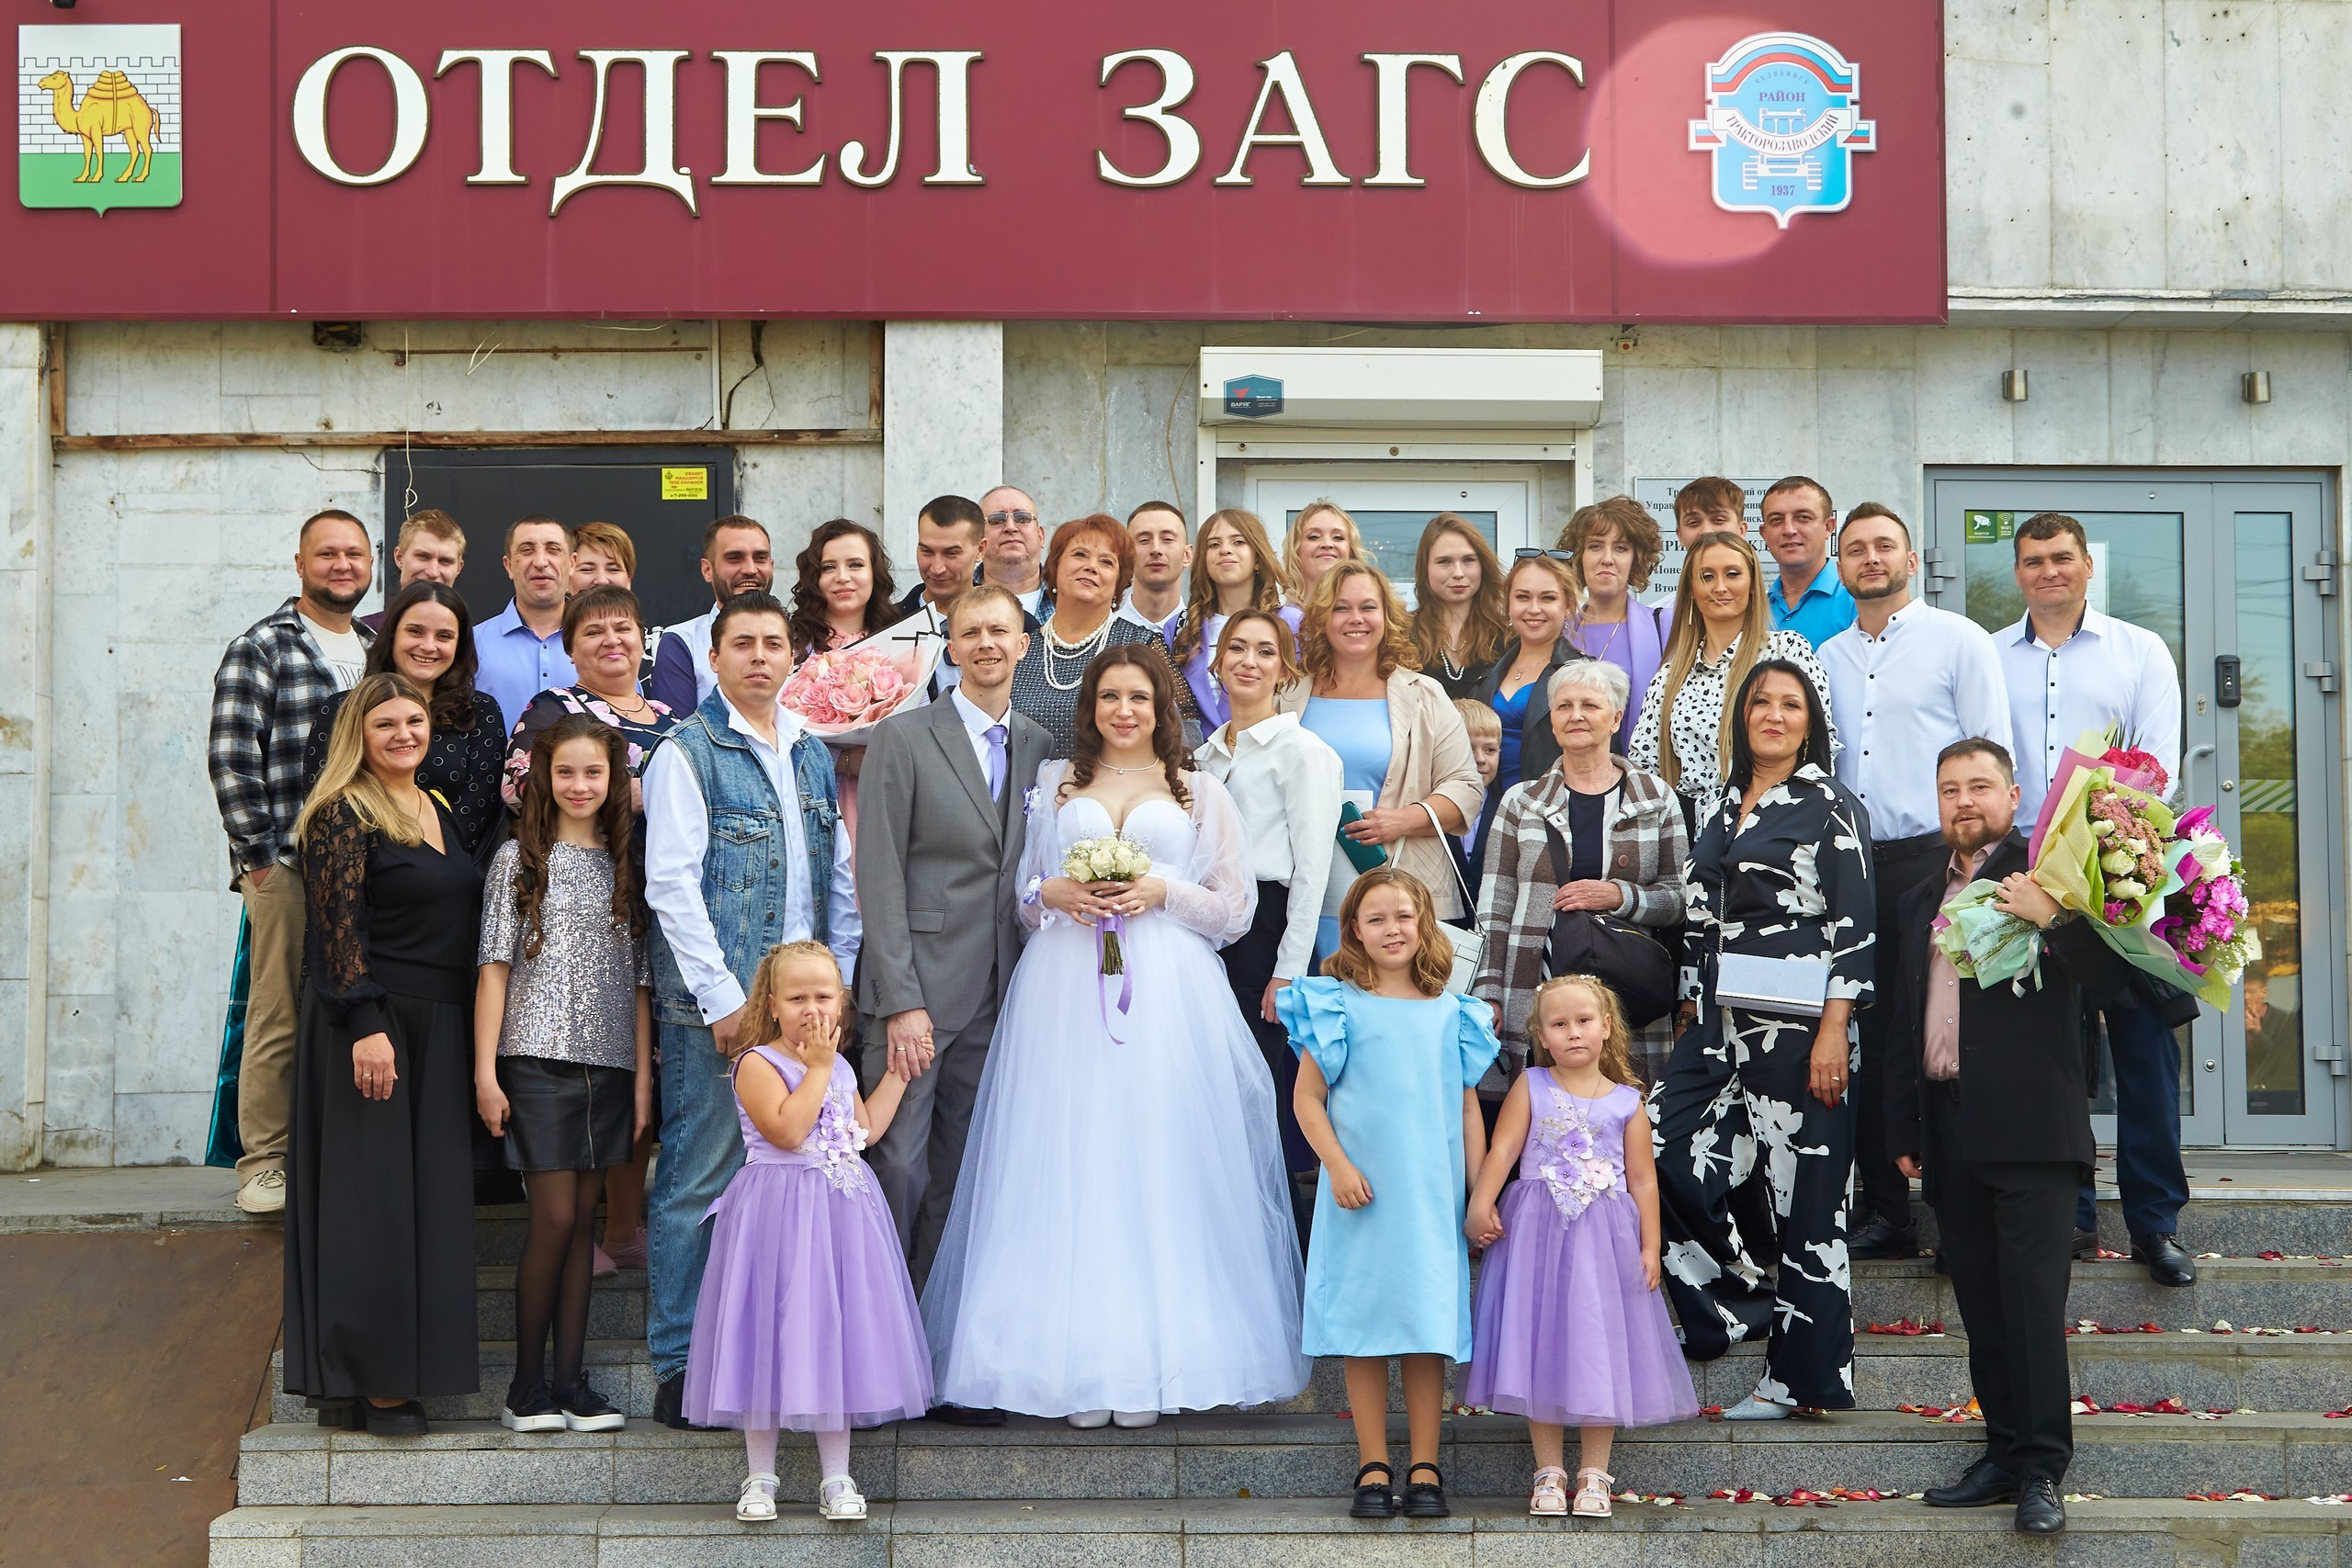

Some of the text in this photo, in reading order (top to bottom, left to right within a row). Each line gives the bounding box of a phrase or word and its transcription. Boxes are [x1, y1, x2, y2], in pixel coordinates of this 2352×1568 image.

[1755, 70, 1810, 85] ЧЕЛЯБИНСК
[1758, 90, 1805, 102] РАЙОН
[291, 44, 1592, 218] ОТДЕЛ ЗАГС
[1726, 113, 1840, 152] ТРАКТОРОЗАВОДСКИЙ
[1770, 185, 1795, 197] 1937
[1645, 501, 1675, 512] Управ
